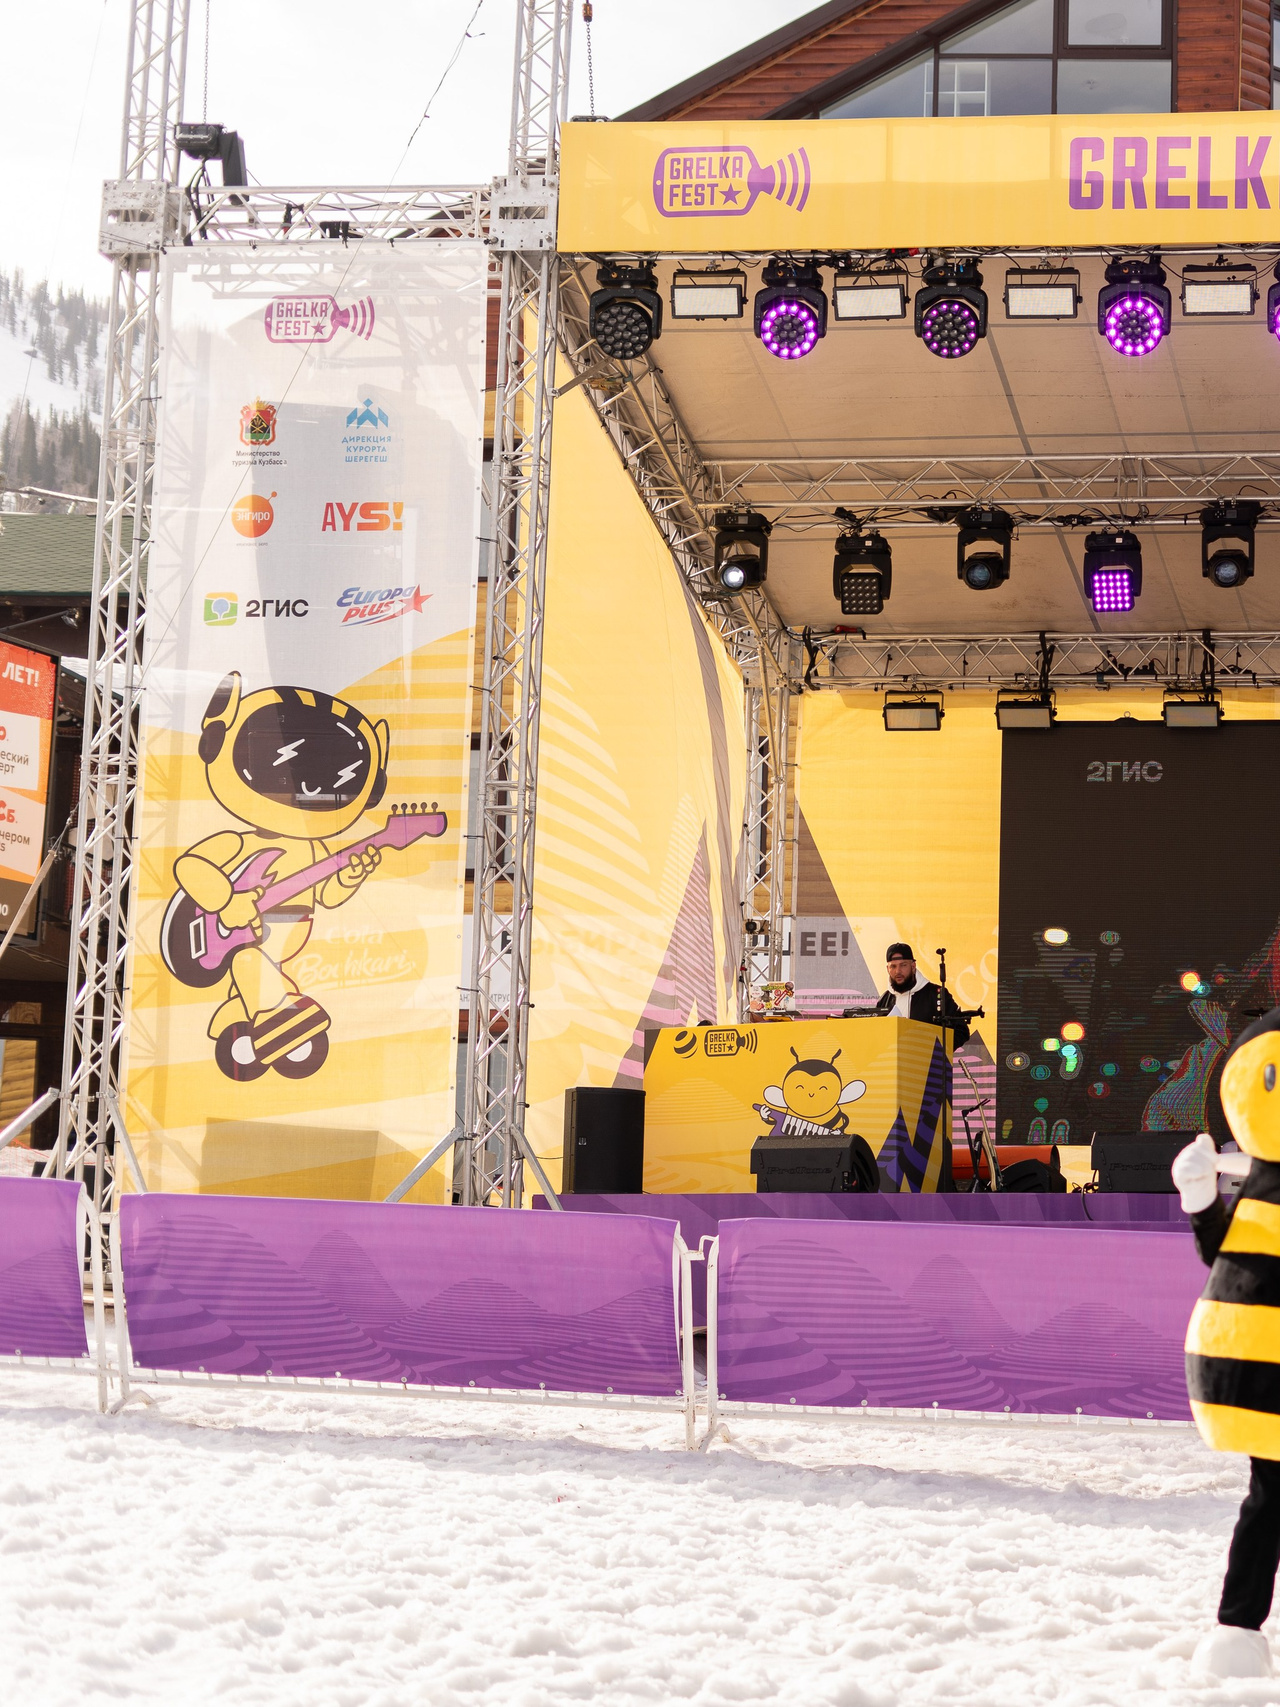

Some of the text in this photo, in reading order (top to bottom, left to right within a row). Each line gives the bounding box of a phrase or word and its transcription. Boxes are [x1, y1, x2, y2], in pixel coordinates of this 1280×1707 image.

[670, 156, 743, 180] GRELKA
[669, 183, 719, 207] FEST
[276, 302, 329, 318] GRELKA
[275, 320, 311, 336] FEST
[341, 435, 392, 444] ДИРЕКЦИЯ
[346, 446, 387, 454] КУРОРТА
[345, 456, 388, 464] ШЕРЕГЕШ
[321, 501, 405, 532] AYS!
[246, 599, 310, 618] 2ГИС
[2, 661, 40, 687] ЛЕТ!
[1086, 761, 1164, 783] 2ГИС
[709, 1032, 736, 1043] GRELKA
[709, 1043, 727, 1053] FEST
[766, 1166, 834, 1175] ProTone
[1108, 1162, 1172, 1171] ProTon
